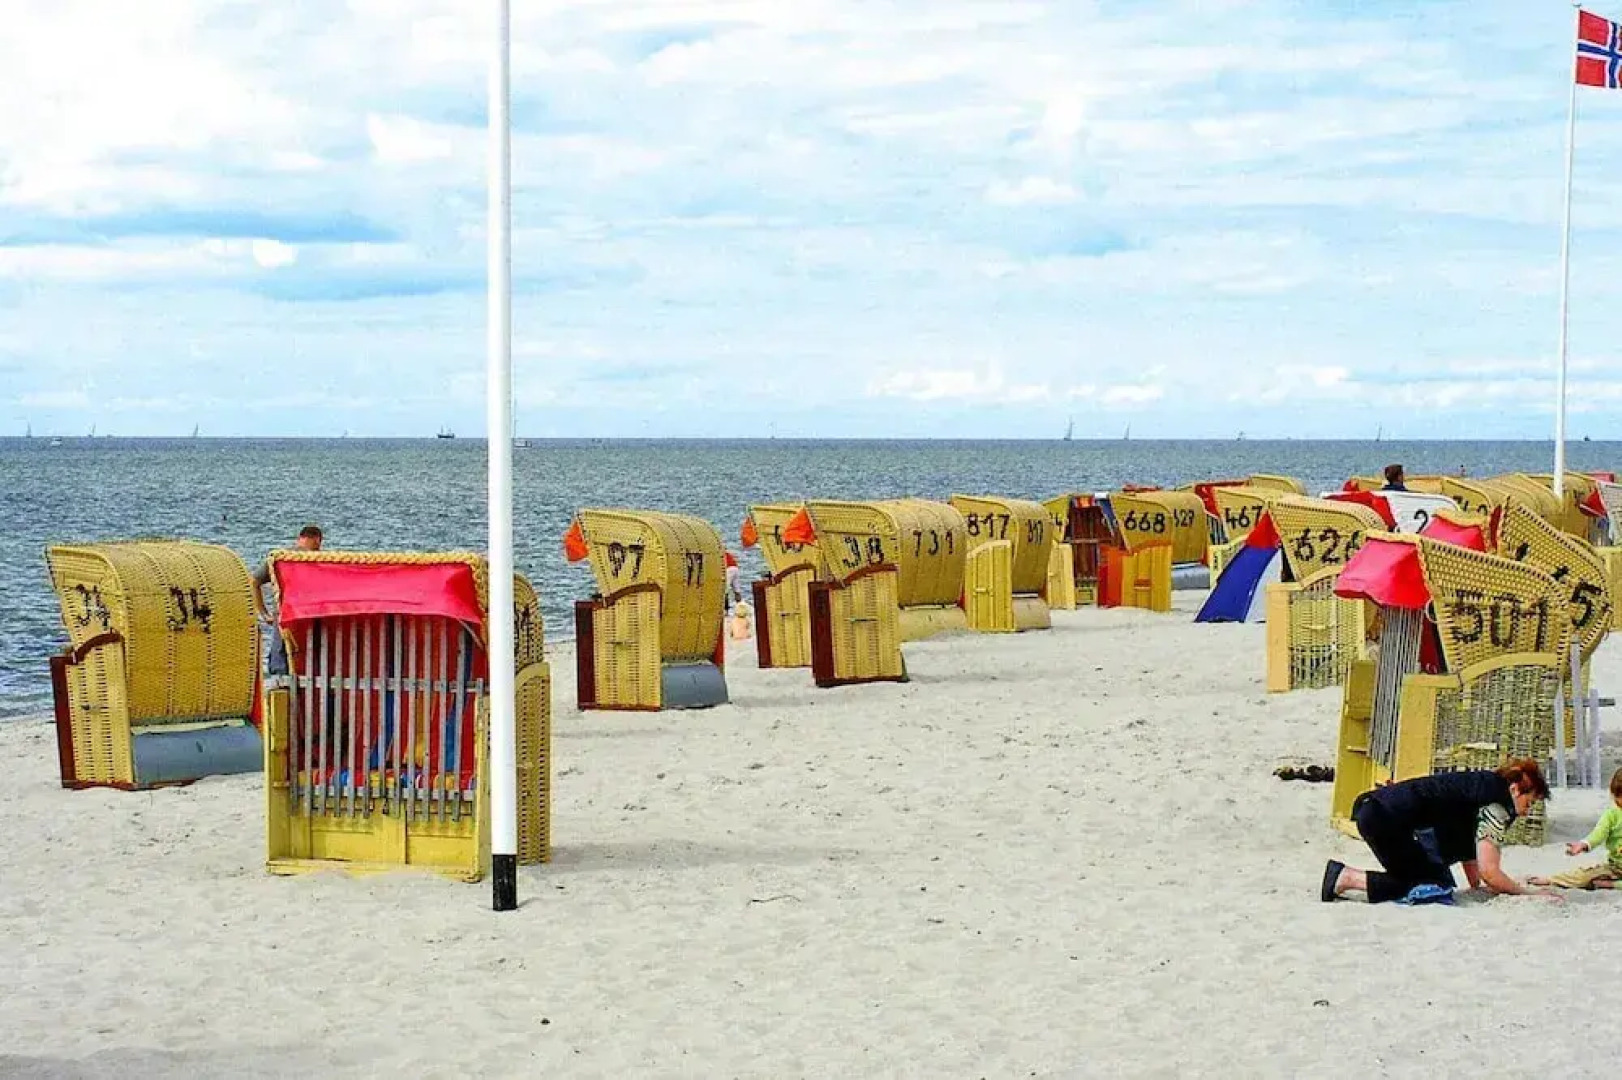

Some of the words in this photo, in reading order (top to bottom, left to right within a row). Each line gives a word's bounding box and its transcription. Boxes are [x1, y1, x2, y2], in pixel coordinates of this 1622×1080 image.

[967, 512, 1009, 540] 817
[1124, 511, 1166, 533] 668
[1224, 505, 1262, 529] 467
[912, 530, 953, 557] 731
[608, 542, 645, 579] 97
